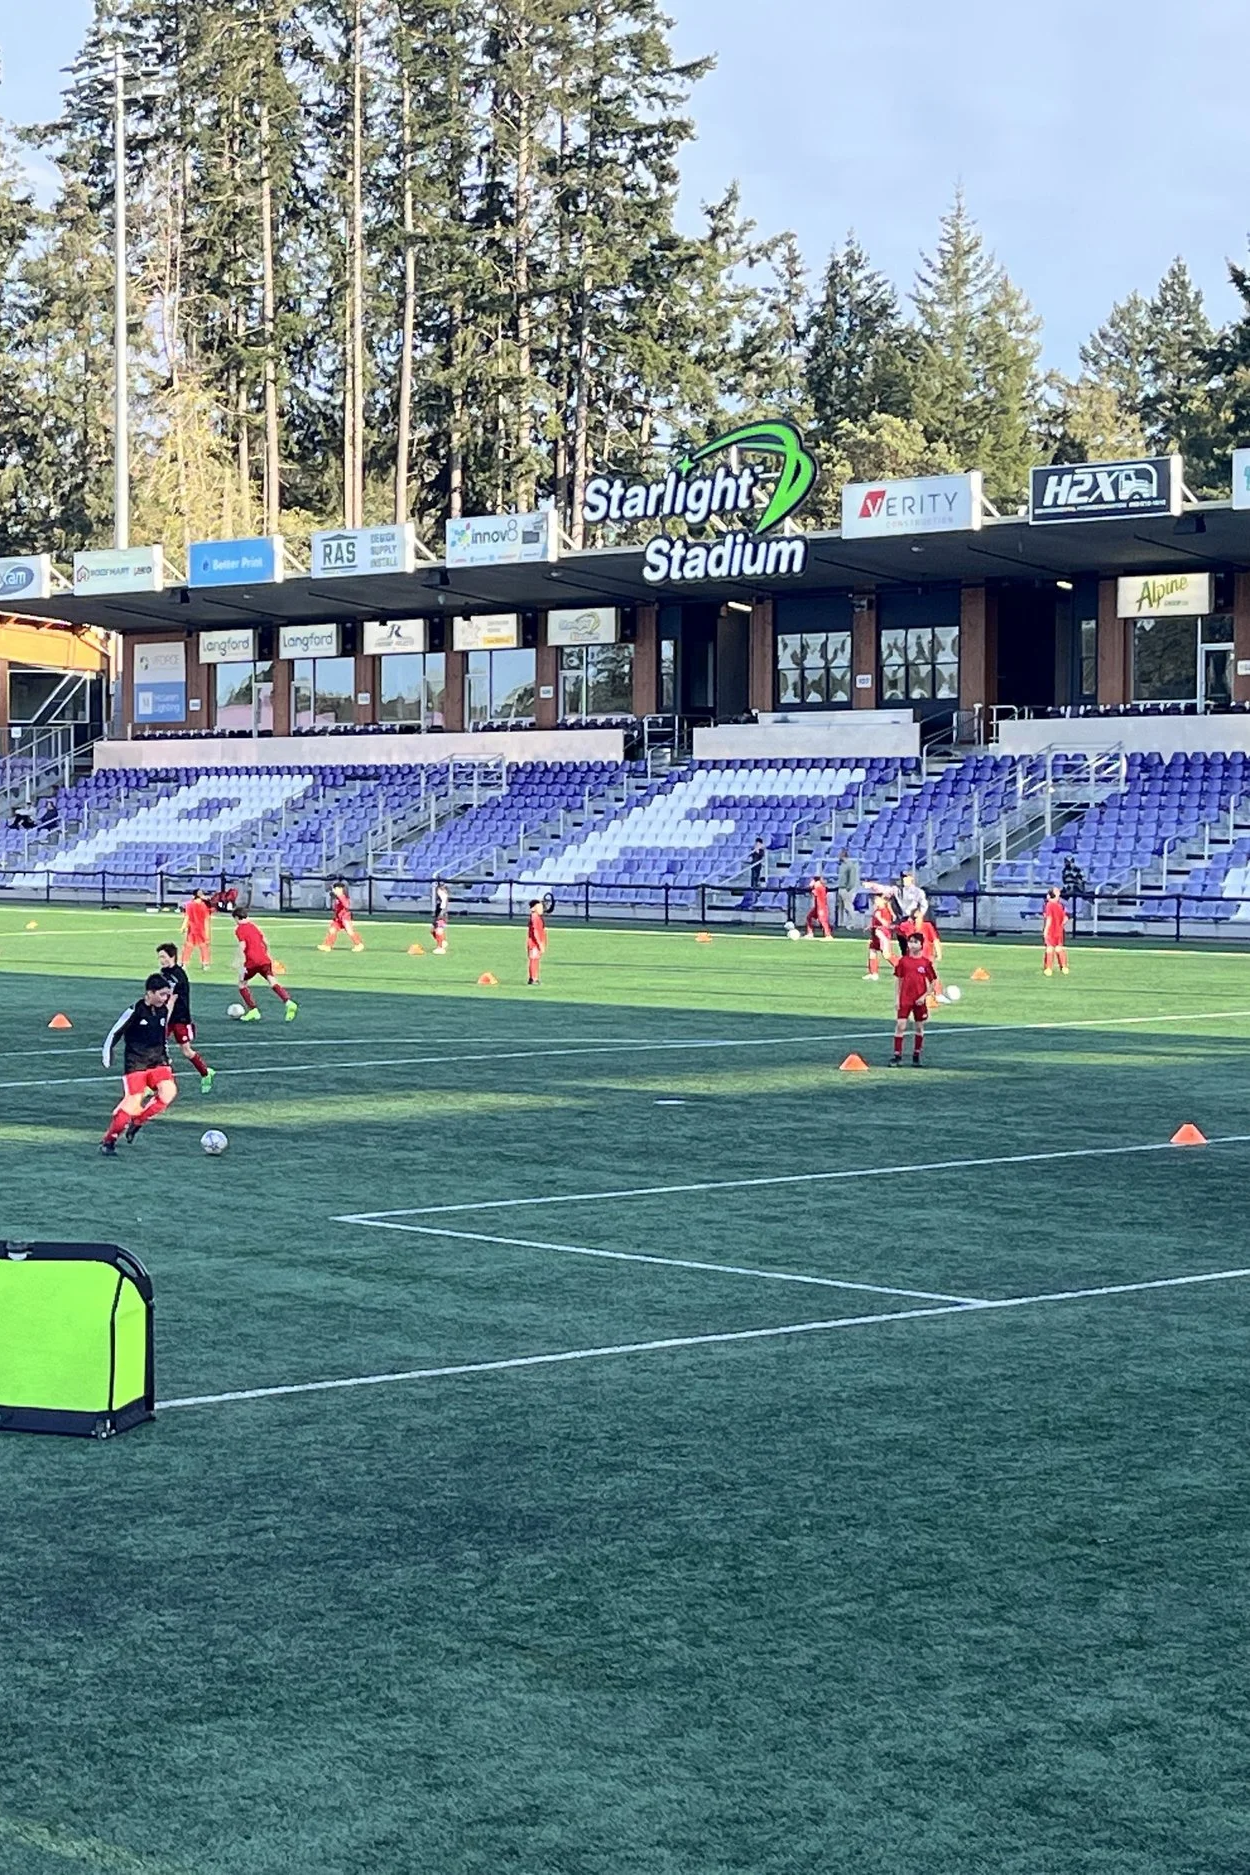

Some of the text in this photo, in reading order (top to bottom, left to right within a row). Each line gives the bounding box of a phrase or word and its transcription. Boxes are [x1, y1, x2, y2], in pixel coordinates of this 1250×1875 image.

[583, 466, 754, 524] Starlight
[863, 491, 958, 517] VERITY
[1043, 471, 1119, 506] H2X
[471, 519, 518, 544] innov8
[322, 542, 356, 565] RAS
[643, 532, 805, 581] Stadium
[1135, 576, 1189, 612] Alpine
